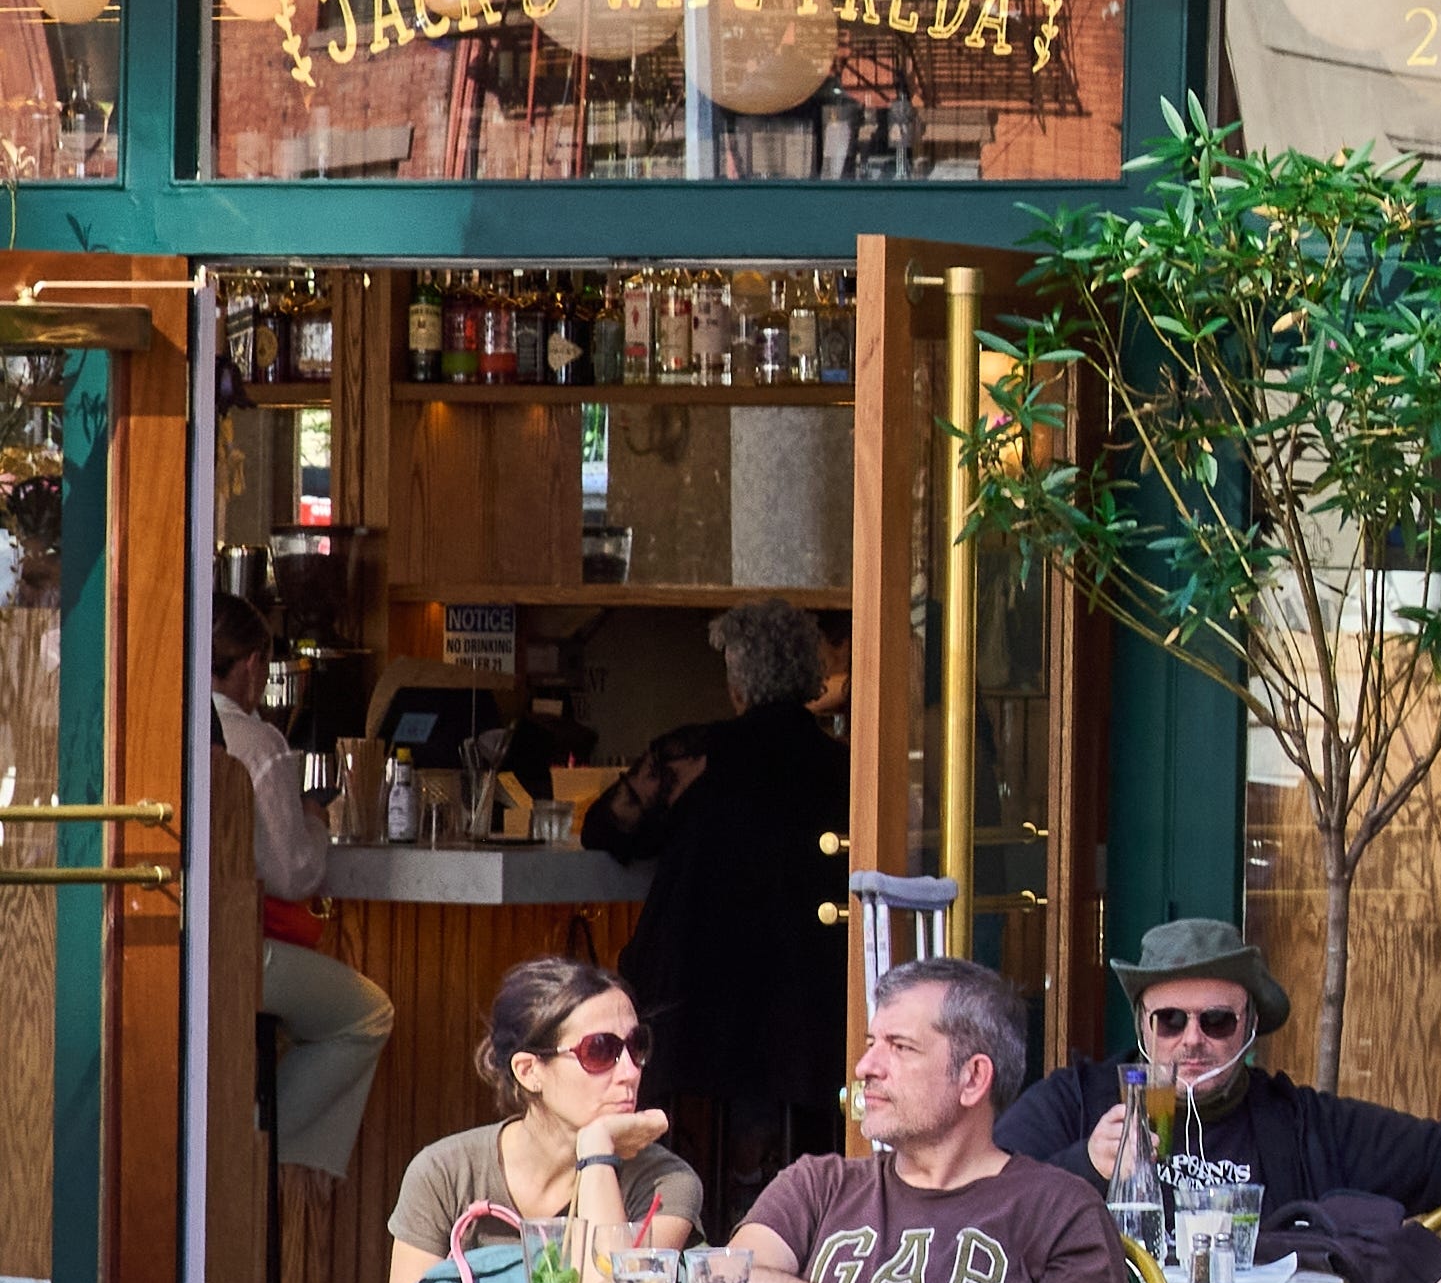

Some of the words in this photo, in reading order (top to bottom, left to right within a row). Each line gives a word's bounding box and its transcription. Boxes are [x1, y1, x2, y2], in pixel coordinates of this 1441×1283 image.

[448, 608, 511, 630] NOTICE
[446, 638, 461, 653] NO
[464, 638, 512, 654] DRINKING
